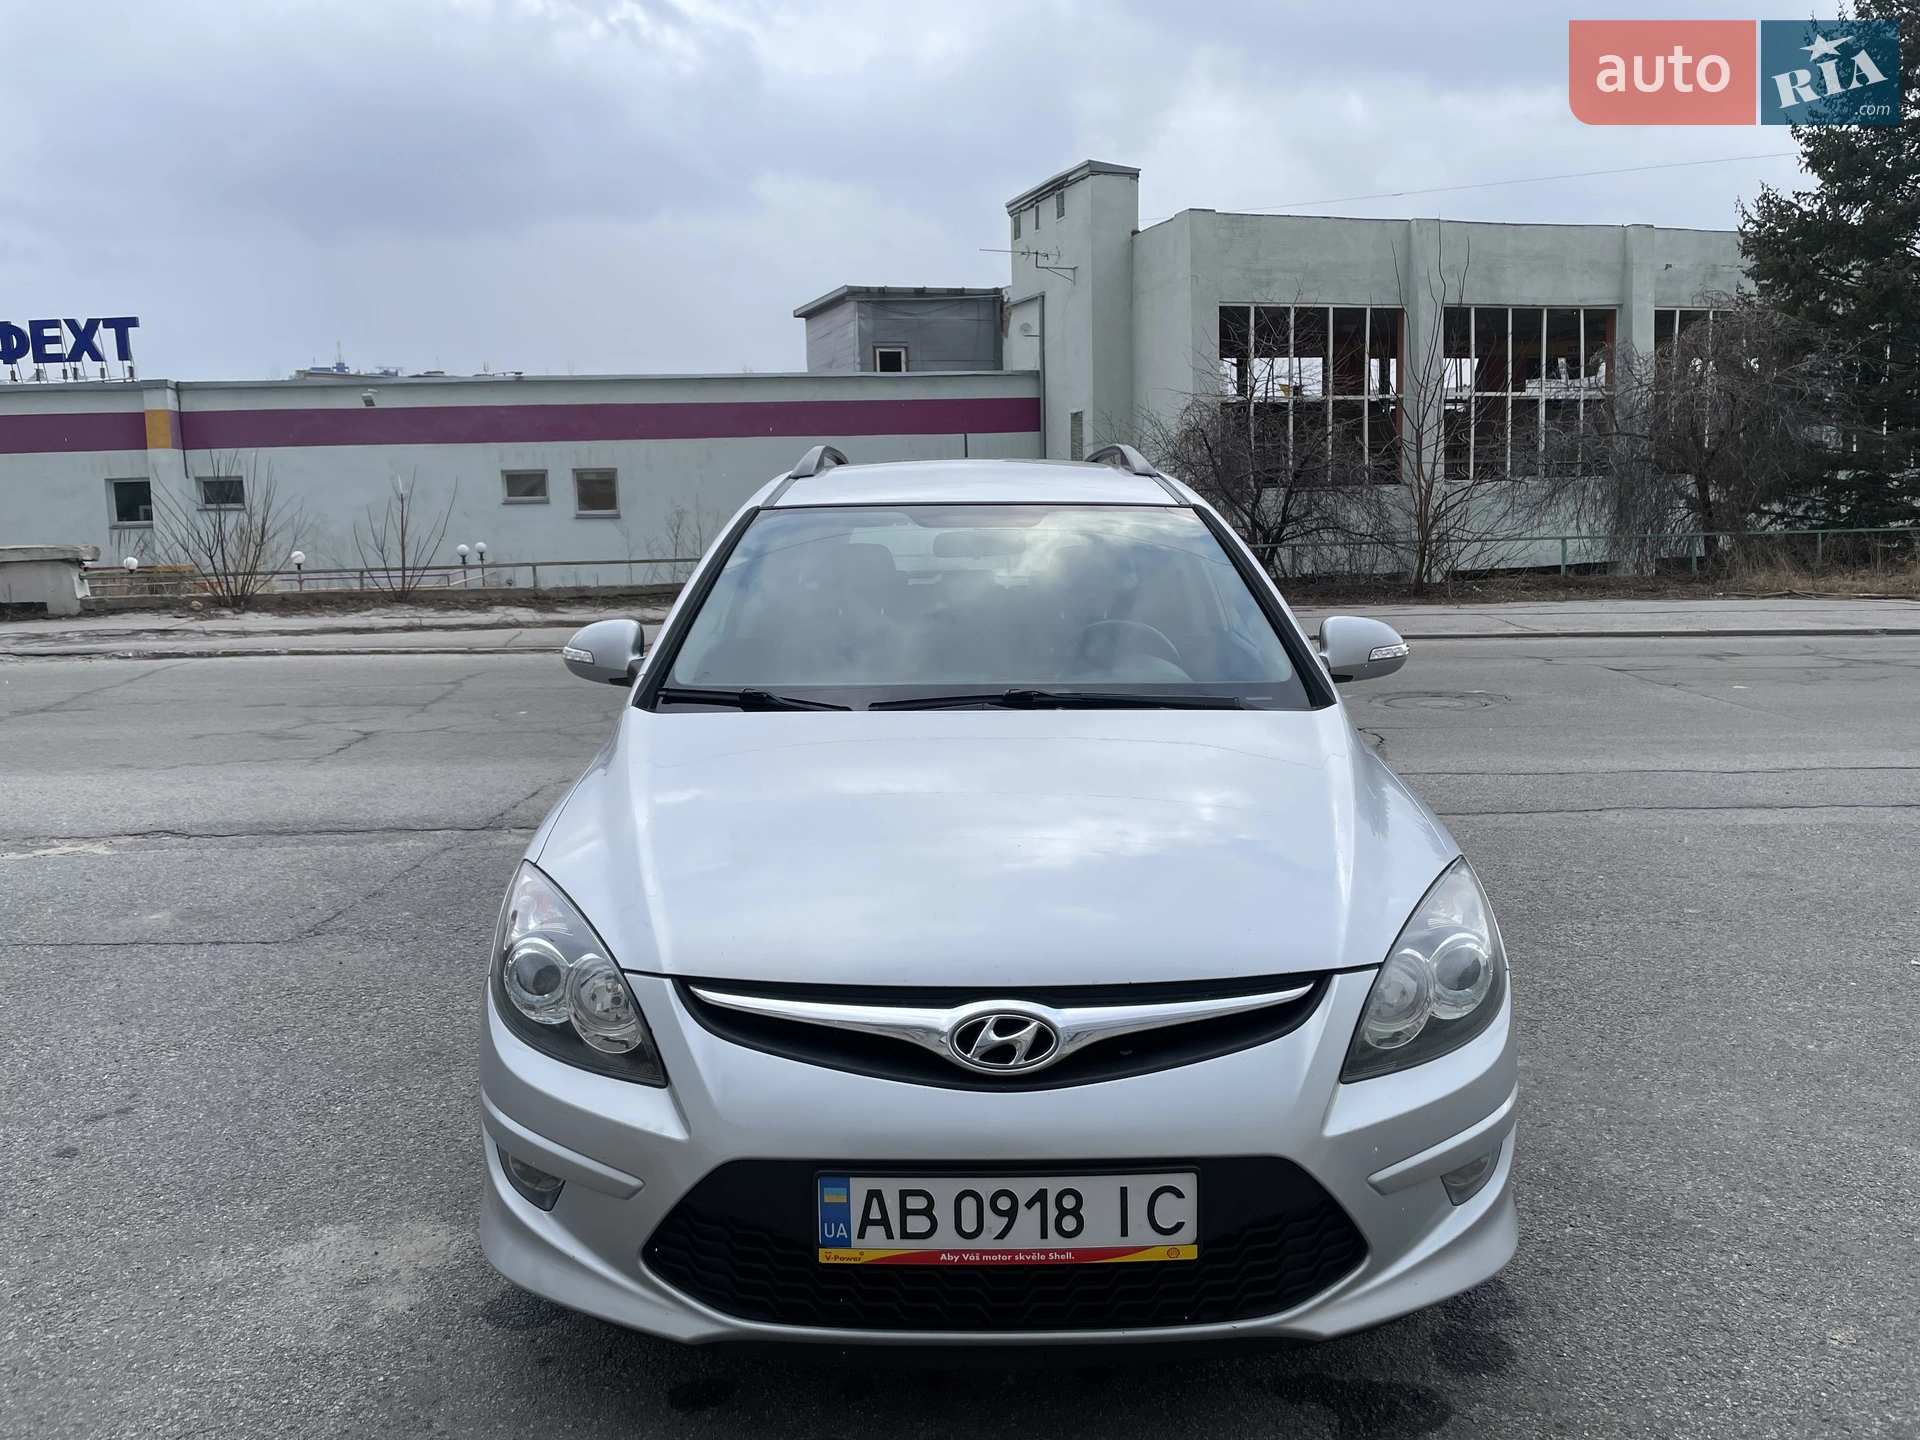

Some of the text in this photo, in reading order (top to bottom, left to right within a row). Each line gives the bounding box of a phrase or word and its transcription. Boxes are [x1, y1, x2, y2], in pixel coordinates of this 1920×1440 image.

[0, 316, 139, 364] ФЕХТ
[856, 1184, 1186, 1240] AB 0918 IC
[823, 1222, 848, 1239] UA
[940, 1251, 1075, 1263] Aby Váš motor skvěle Shell.
